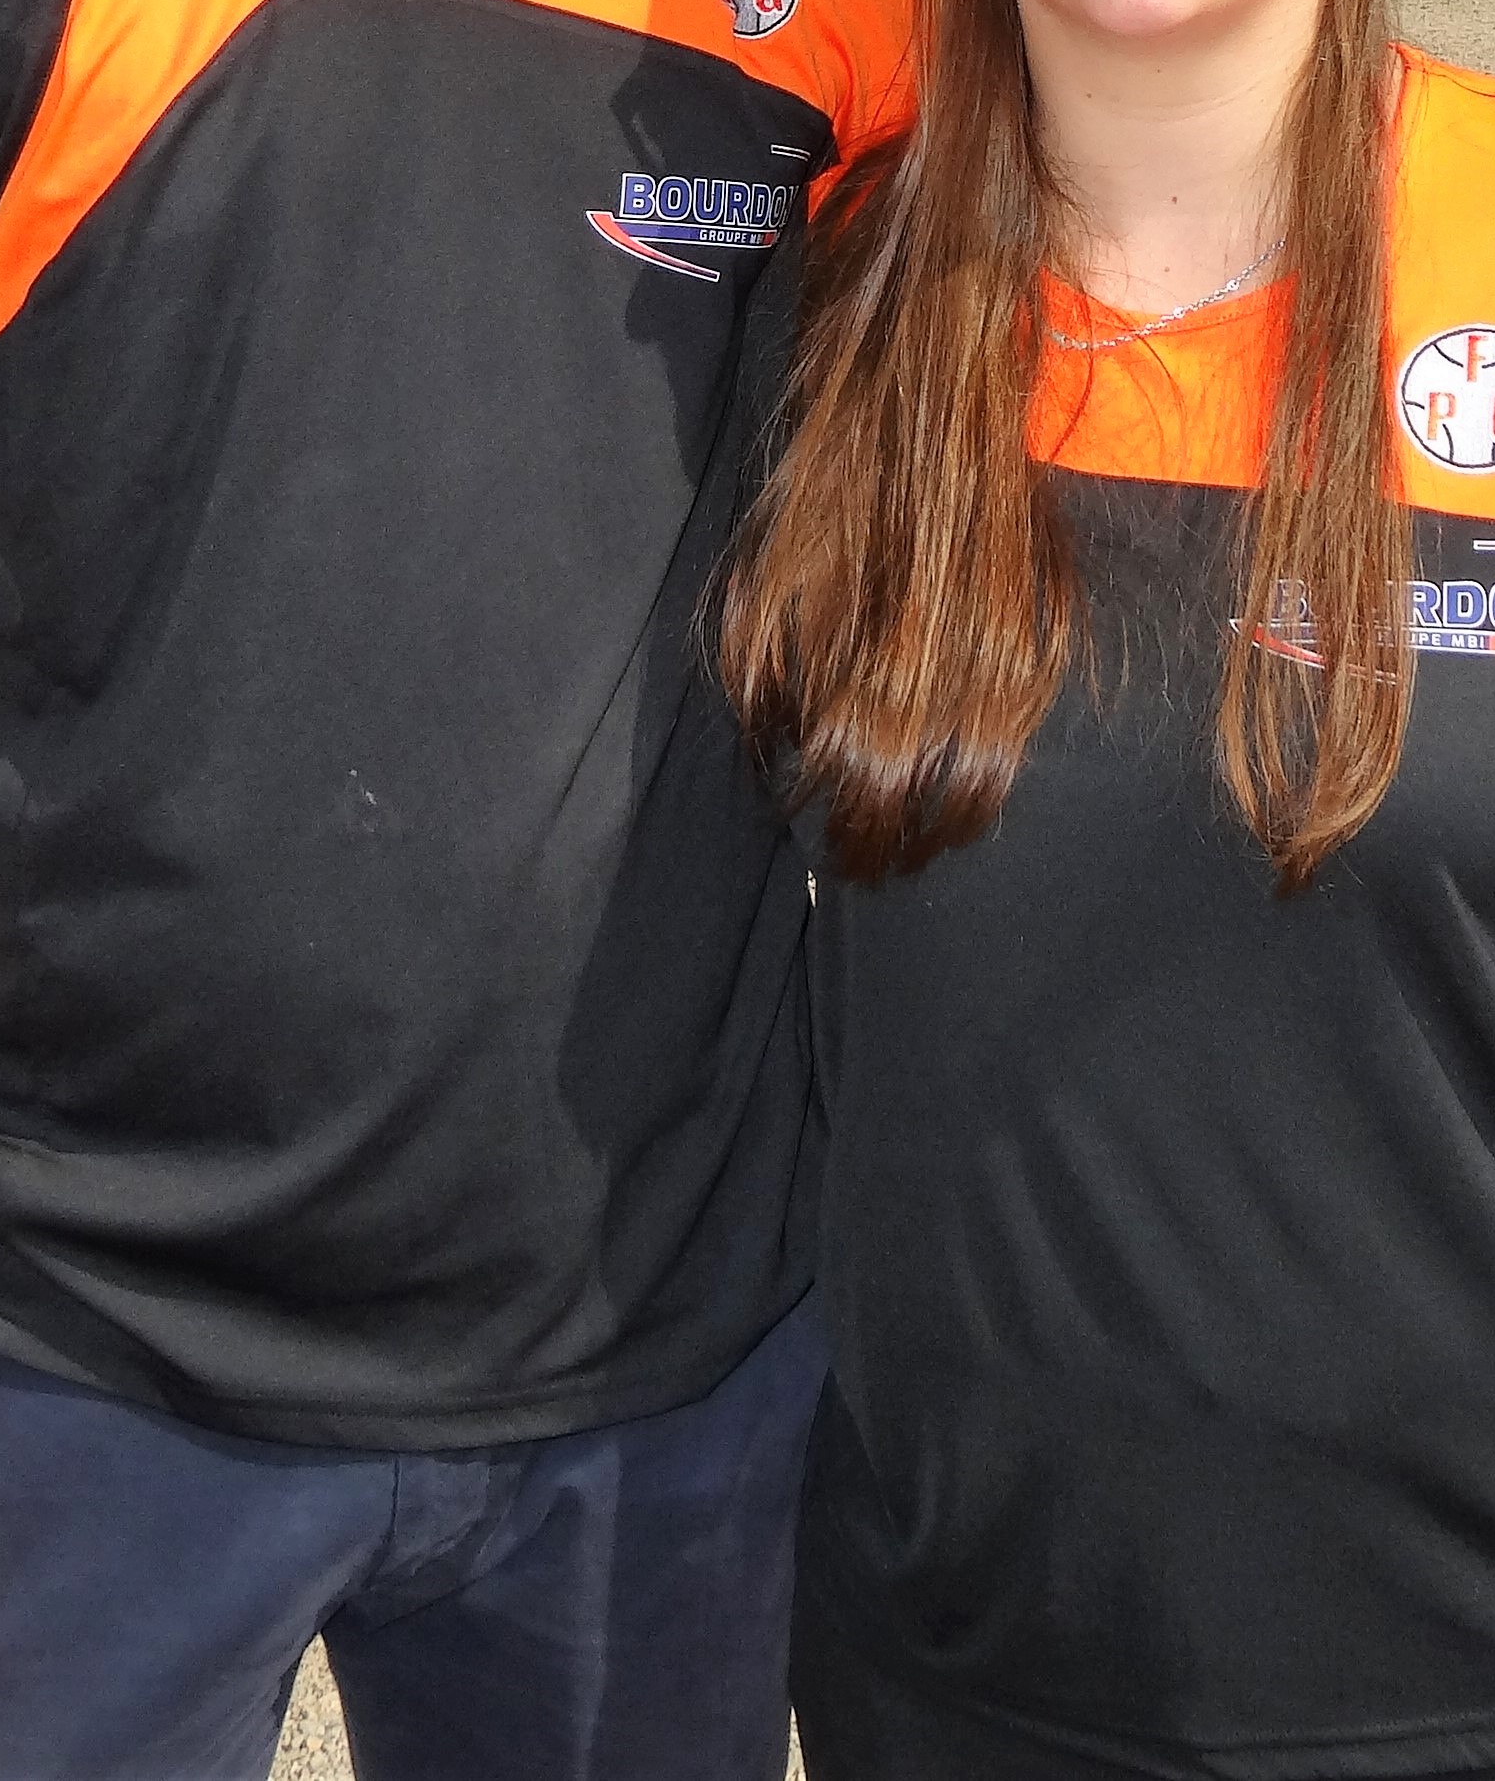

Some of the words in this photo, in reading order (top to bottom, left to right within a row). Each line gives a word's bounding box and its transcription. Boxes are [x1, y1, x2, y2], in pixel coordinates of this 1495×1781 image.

[698, 229, 748, 244] GROUPE
[1463, 334, 1489, 384] F
[1426, 391, 1457, 441] P
[1450, 633, 1486, 649] MBI
